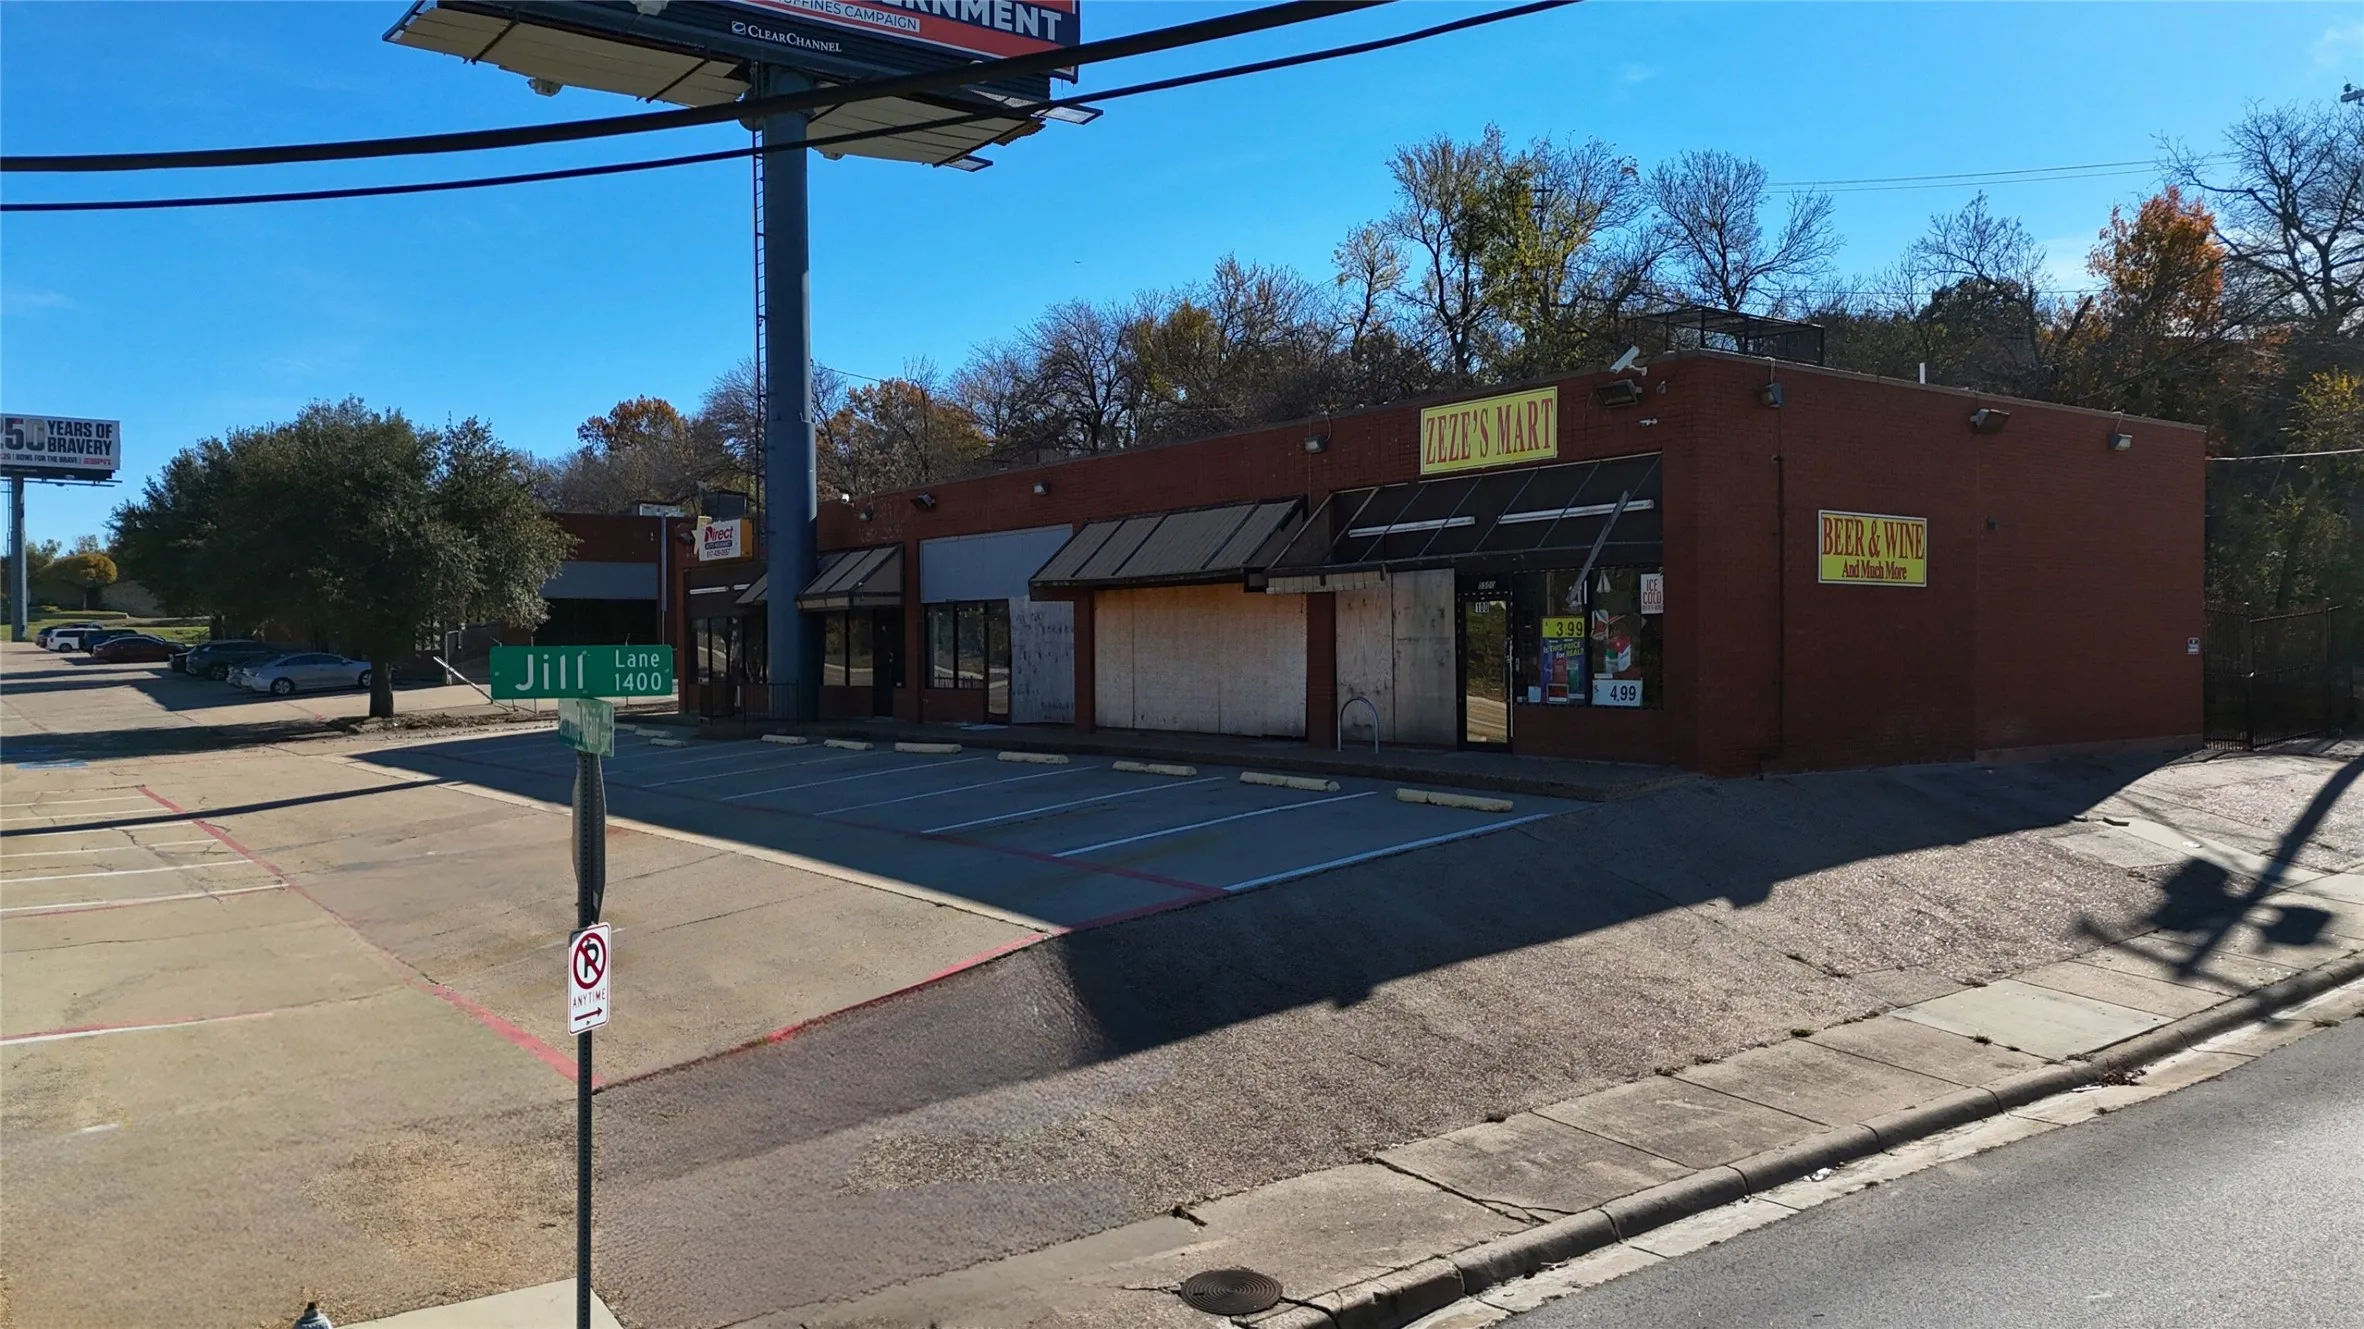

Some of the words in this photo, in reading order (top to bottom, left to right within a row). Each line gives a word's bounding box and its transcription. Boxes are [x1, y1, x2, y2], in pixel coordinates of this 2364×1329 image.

[845, 6, 917, 30] CAMPAIGN
[880, 0, 1062, 40] NMENT
[0, 418, 45, 451] 50
[47, 420, 92, 438] YEARS
[96, 423, 113, 439] OF
[1426, 407, 1489, 465] ZEZE'S
[1496, 397, 1553, 455] MART
[47, 436, 113, 456] BRAVERY
[704, 526, 733, 543] Direct
[1822, 516, 1865, 557] BEER
[1868, 519, 1881, 559] &
[1883, 520, 1925, 560] WINE
[1842, 559, 1860, 579] And
[1861, 560, 1884, 580] Much
[1885, 561, 1907, 581] More
[1646, 579, 1658, 592] ICE
[1643, 591, 1661, 605] COLD
[1556, 621, 1583, 637] 3.99
[515, 653, 584, 691] Jill
[615, 649, 660, 668] Lane
[614, 672, 662, 692] 1400
[1610, 685, 1637, 702] 4.99
[572, 988, 606, 1009] ANYTIME
